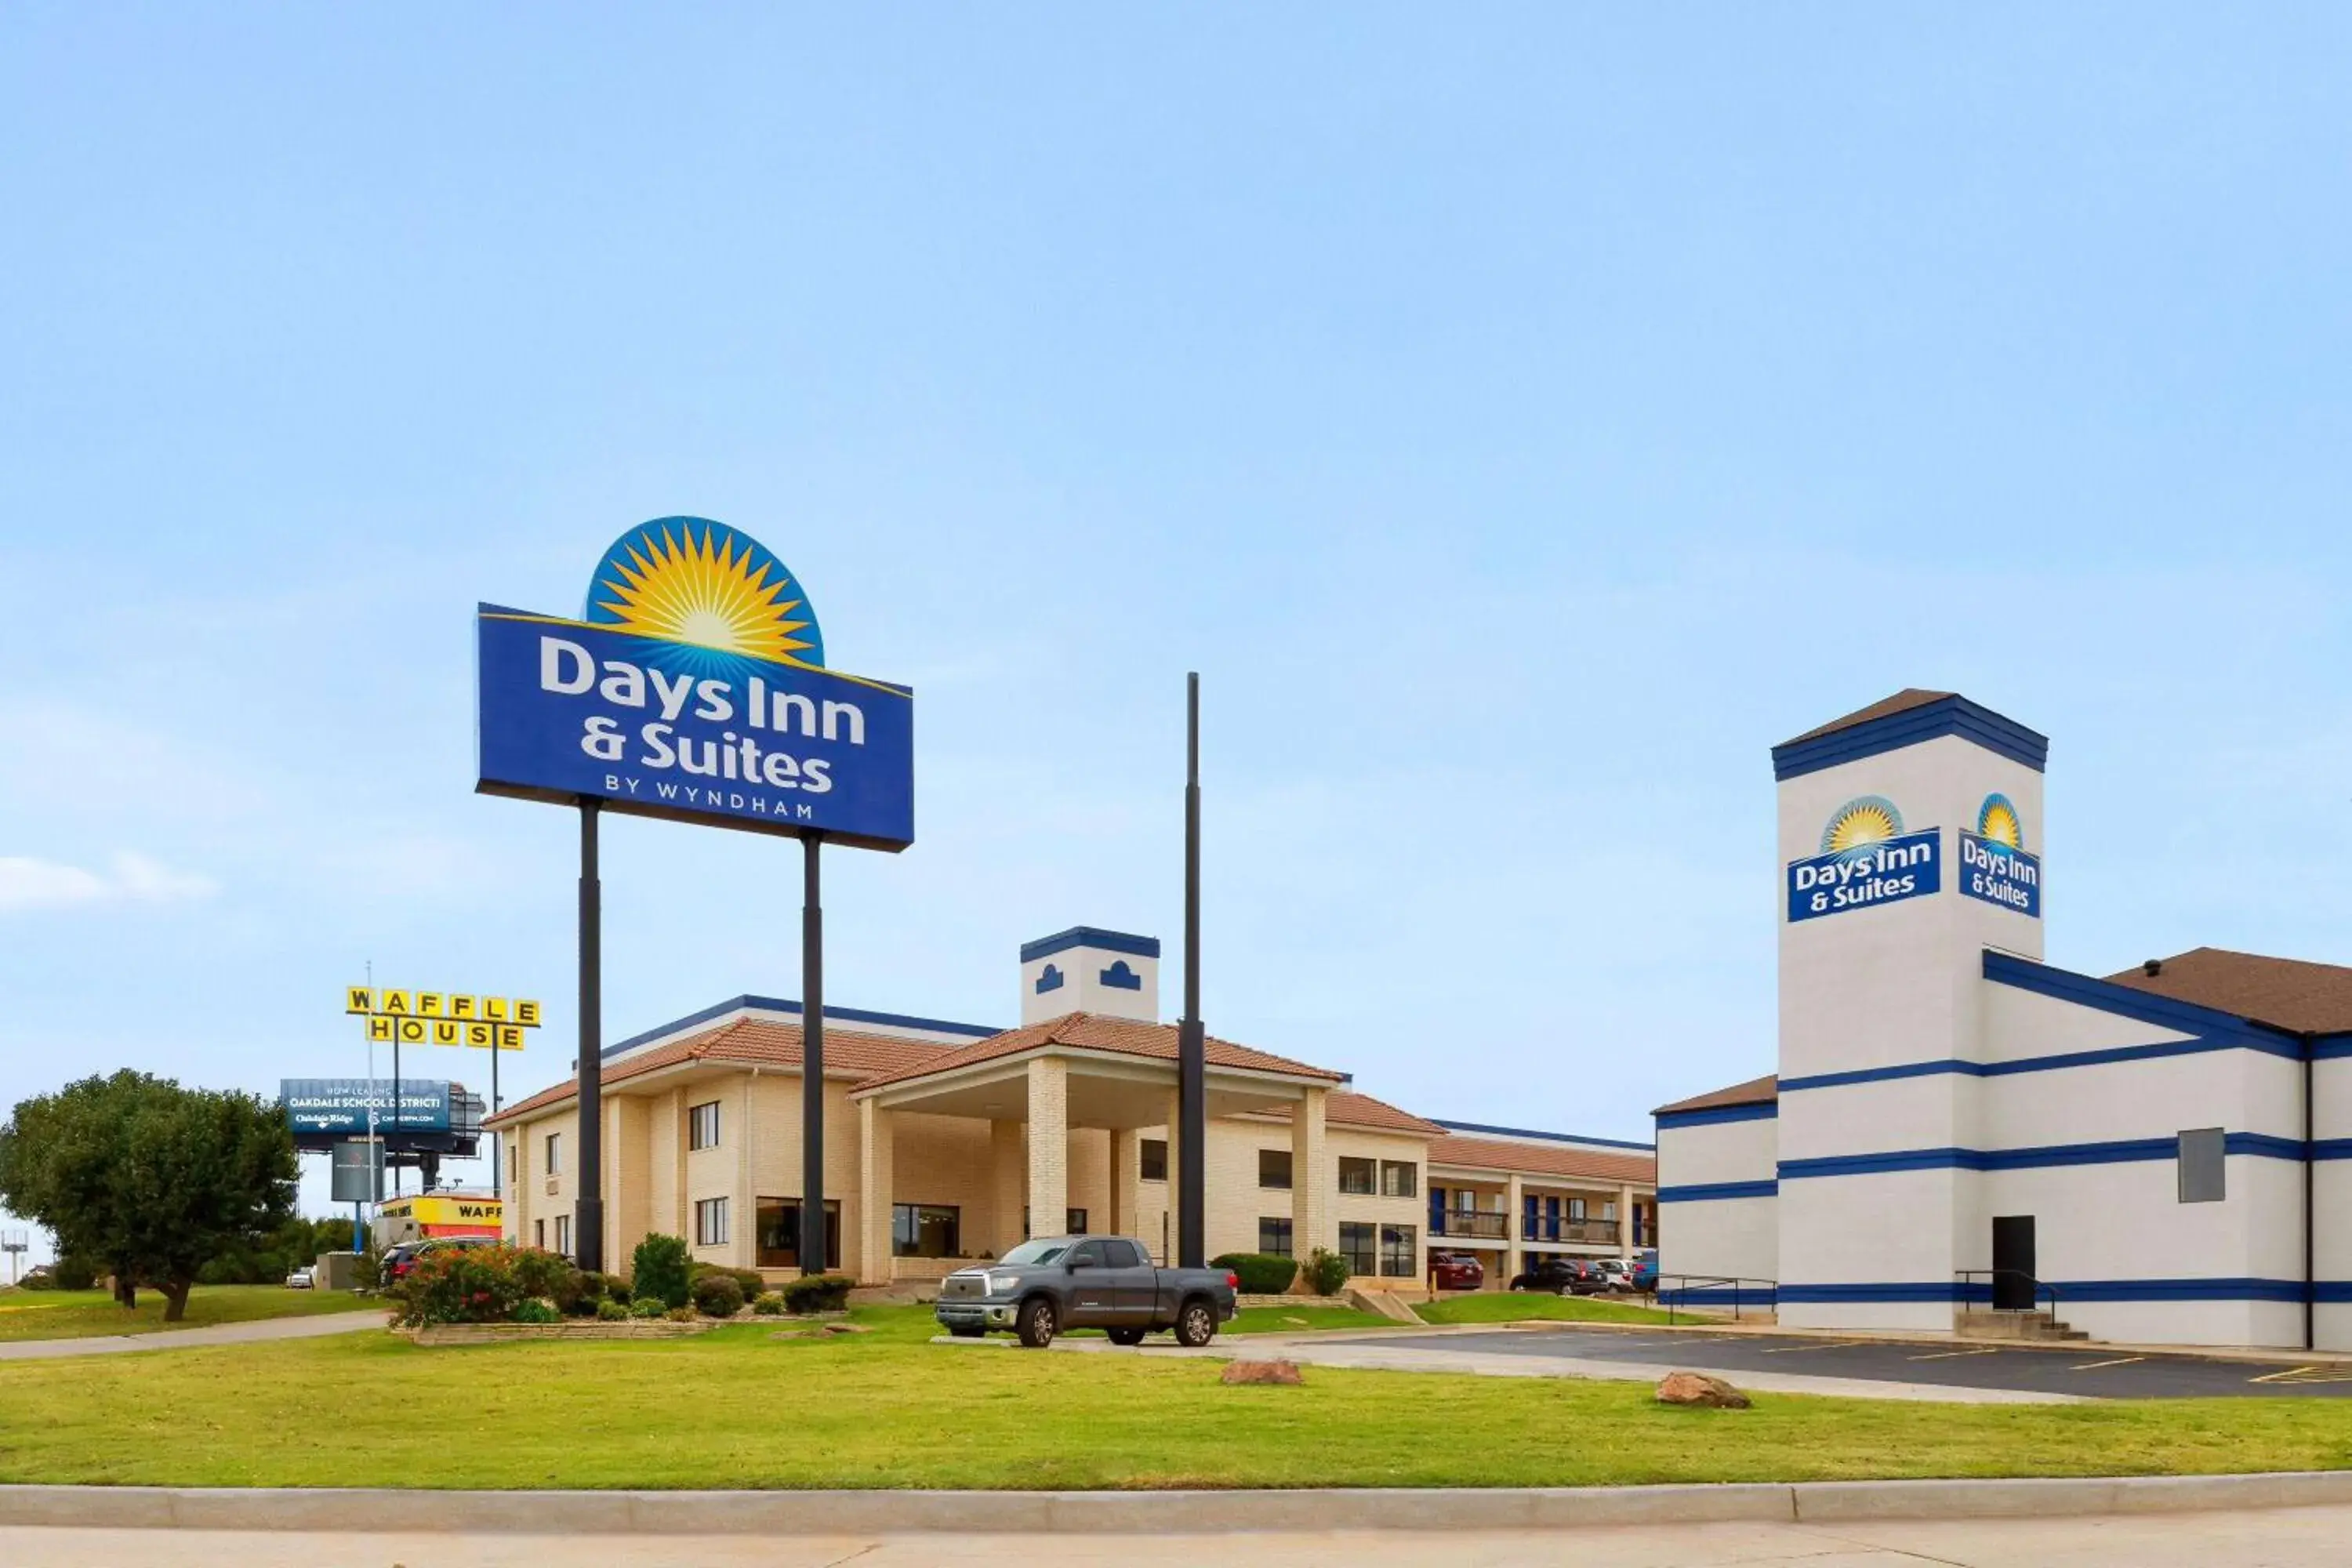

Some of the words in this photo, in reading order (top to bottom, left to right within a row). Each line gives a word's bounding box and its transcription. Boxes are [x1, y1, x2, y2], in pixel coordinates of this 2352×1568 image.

[539, 635, 734, 722] Days
[748, 677, 866, 746] Inn
[579, 715, 626, 761] &
[640, 722, 833, 794] Suites
[605, 775, 641, 795] BY
[656, 782, 813, 821] WYNDHAM
[1795, 855, 1872, 891] Days
[1876, 842, 1932, 874] Inn
[1962, 837, 2006, 876] Days
[2009, 853, 2037, 886] Inn
[1810, 891, 1829, 912] &
[1833, 874, 1915, 907] Suites
[1973, 873, 1986, 892] &
[1986, 875, 2029, 909] Suites
[352, 990, 535, 1021] WAFFLE
[371, 1020, 518, 1046] HOUSE
[289, 1097, 340, 1108] OAKDALE
[342, 1097, 387, 1109] SCHOOL
[389, 1098, 440, 1109] DSTRICT!
[329, 1113, 354, 1124] Ridge
